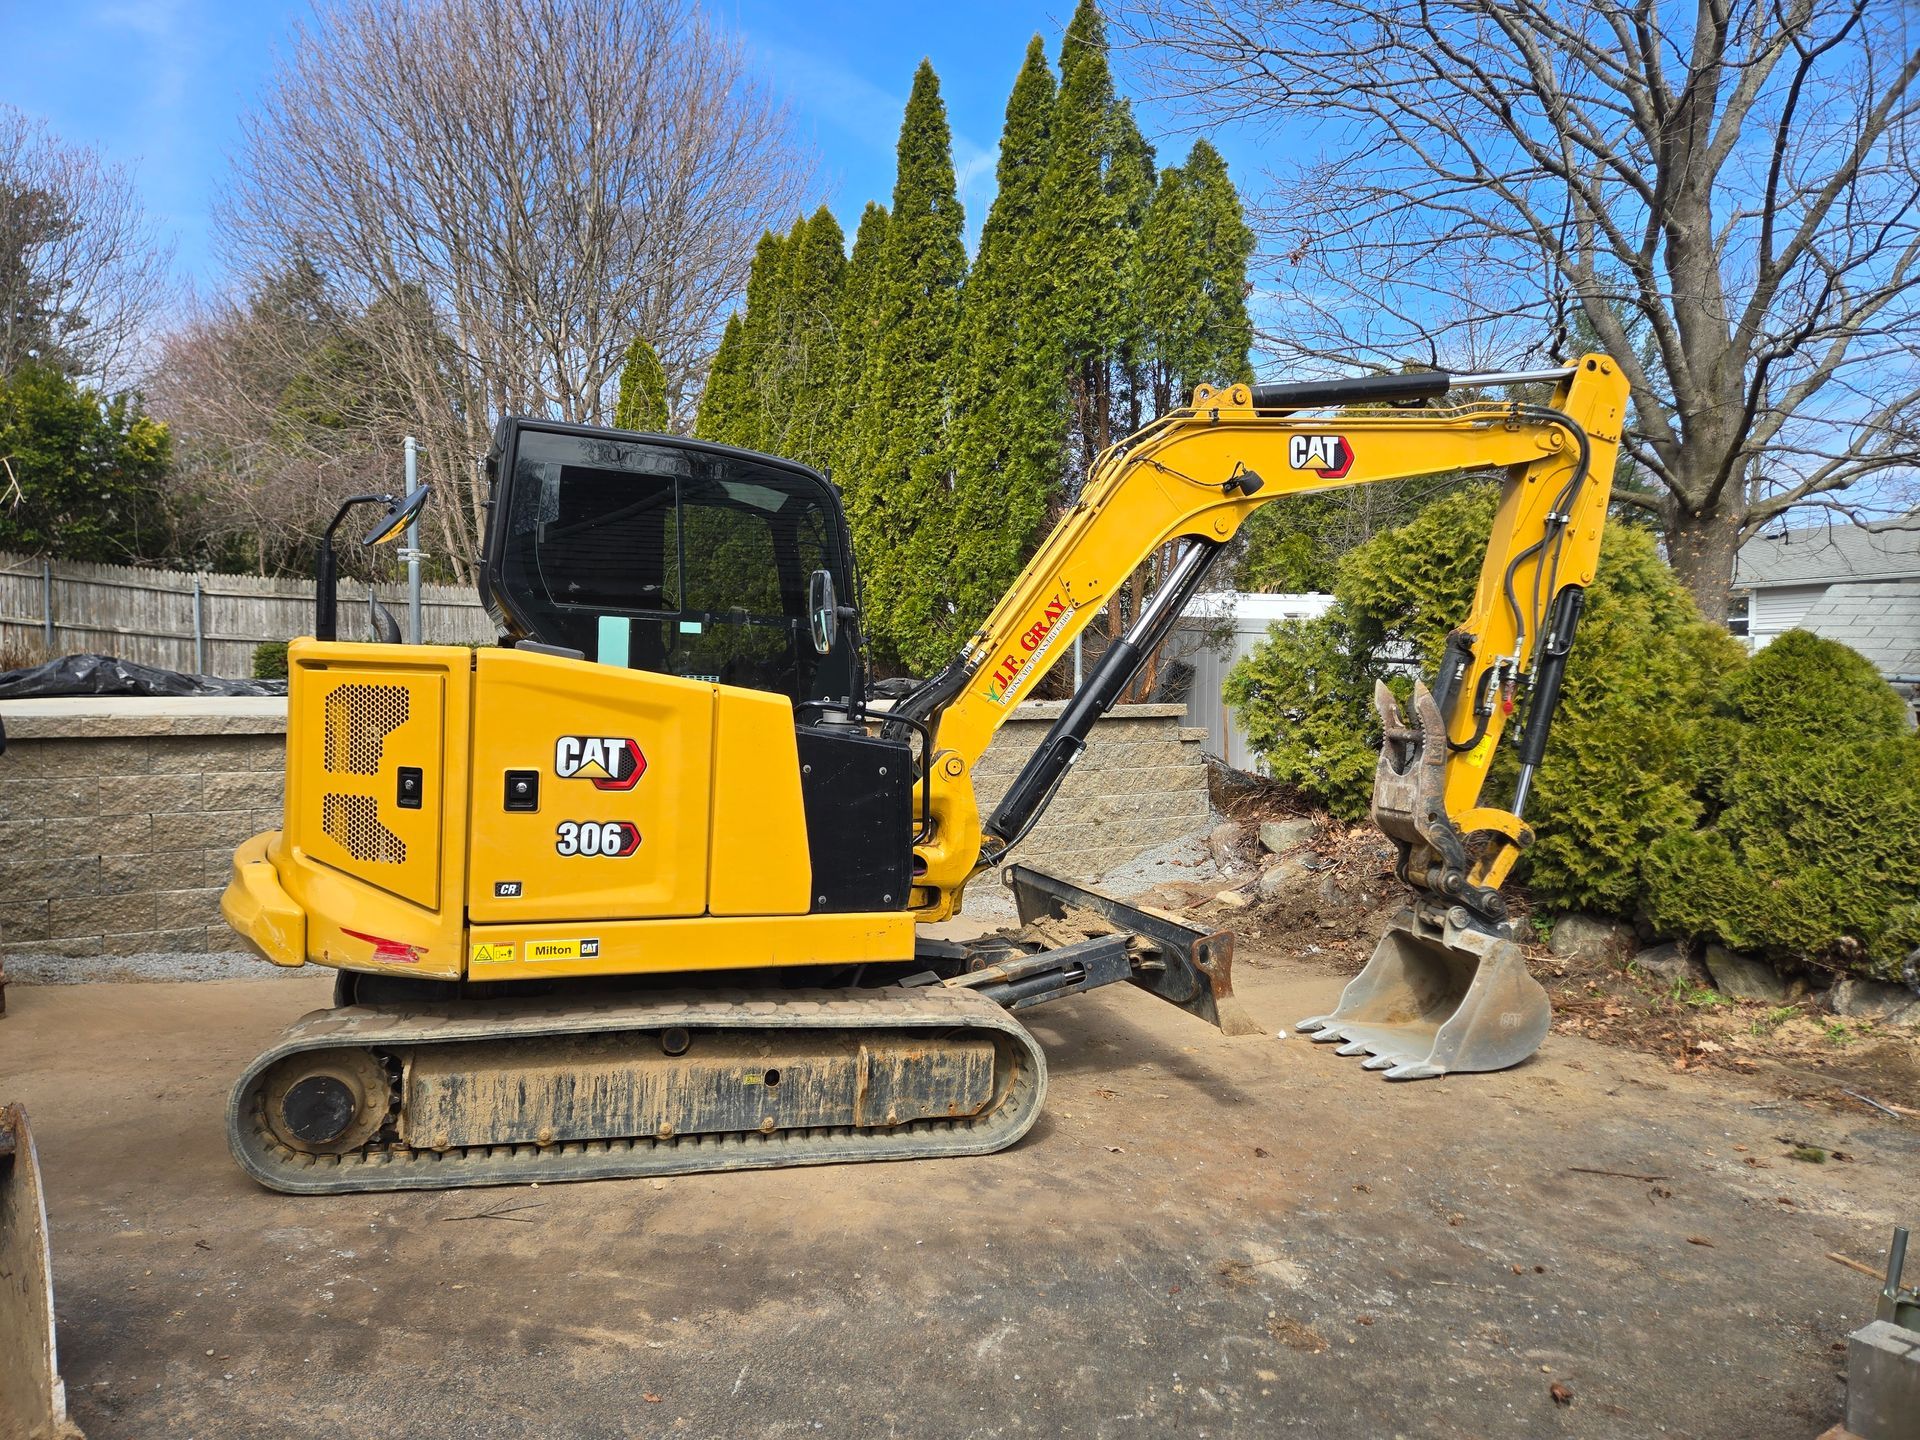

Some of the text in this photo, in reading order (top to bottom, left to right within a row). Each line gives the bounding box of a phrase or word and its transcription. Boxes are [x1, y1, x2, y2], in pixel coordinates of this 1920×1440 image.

[1290, 435, 1339, 469] CAT
[993, 593, 1067, 691] J.F. GRAY
[999, 609, 1074, 705] LANDSCAPE CONSTRUCTION
[556, 736, 626, 779] CAT
[557, 821, 622, 855] 306
[500, 884, 517, 895] CR
[535, 943, 598, 956] Milton CAT
